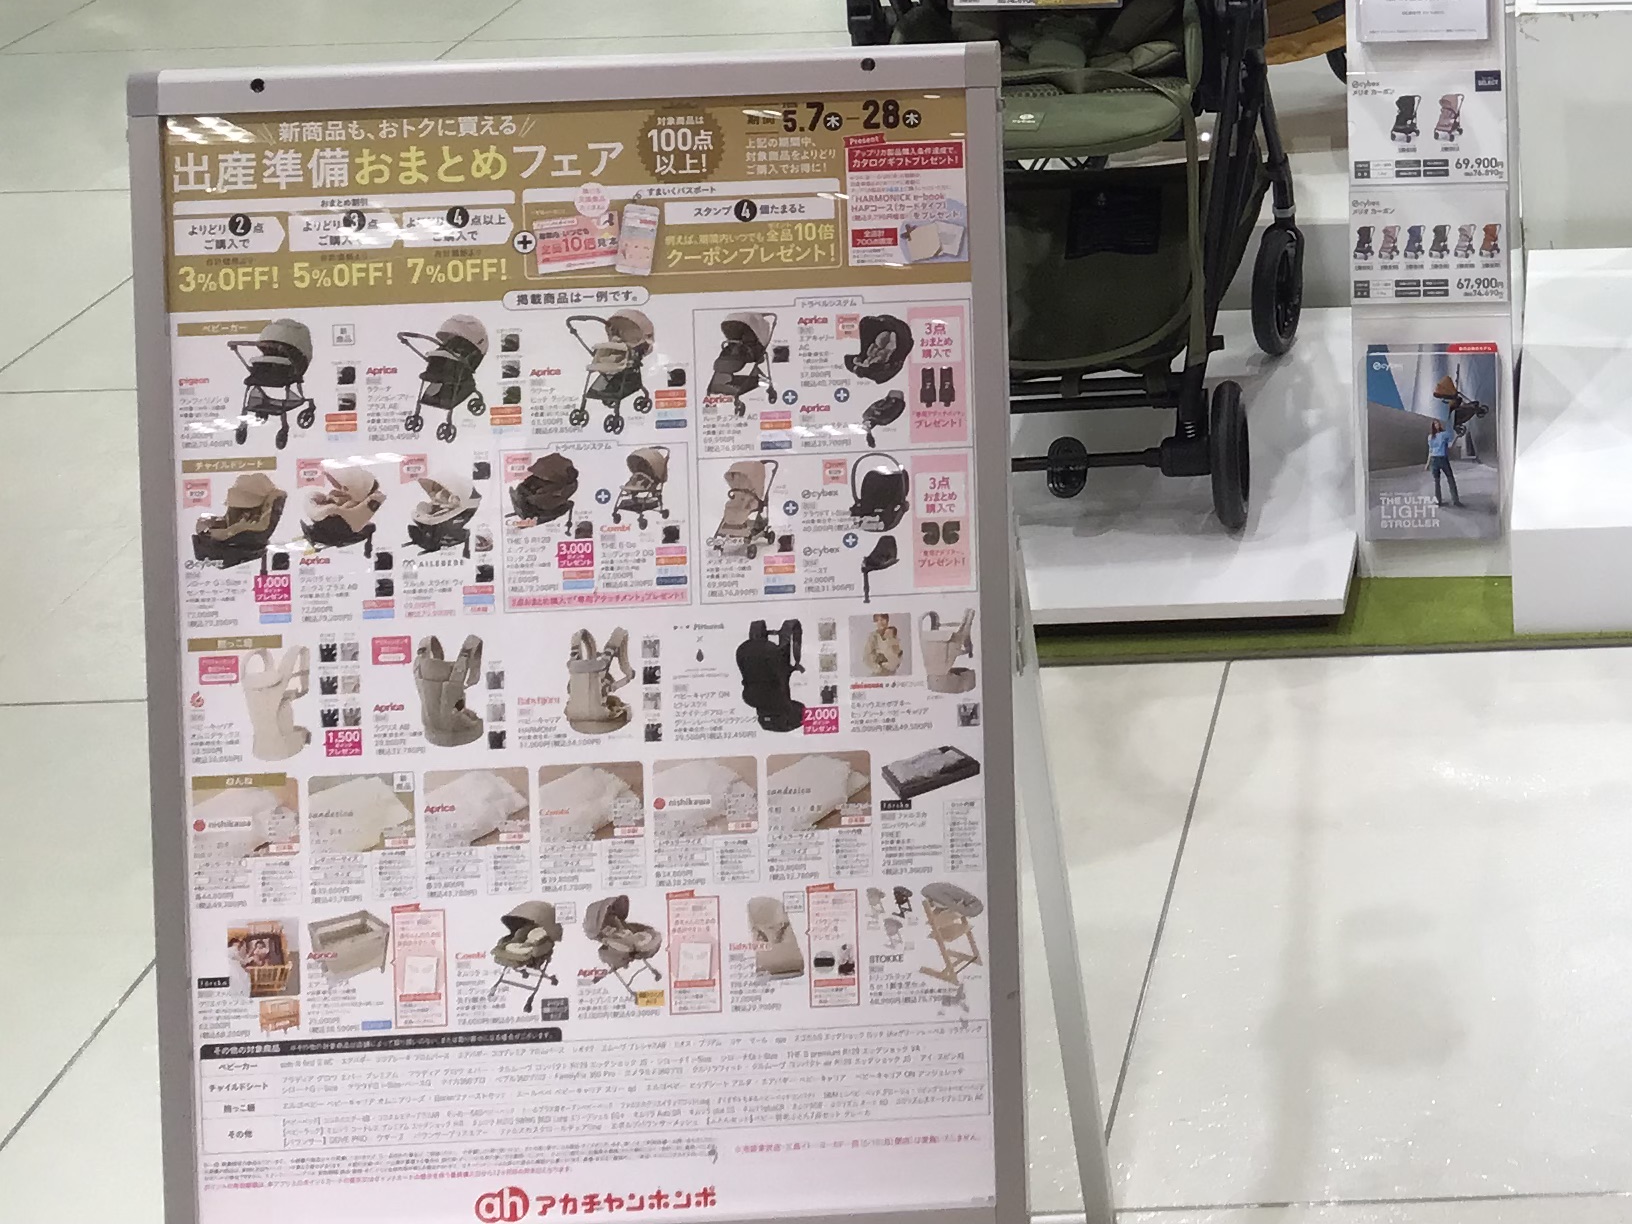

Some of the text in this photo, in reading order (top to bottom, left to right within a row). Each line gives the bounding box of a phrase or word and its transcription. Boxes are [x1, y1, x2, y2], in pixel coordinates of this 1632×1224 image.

[656, 115, 705, 127] 対象商品は
[278, 116, 517, 142] 新商品も、おトクに買える
[646, 126, 714, 154] 100点
[849, 134, 880, 145] Present
[745, 148, 837, 163] 対象商品をよりどり
[173, 141, 625, 194] 出産準備おまとめフェア
[655, 152, 708, 176] 以上!
[646, 185, 717, 197] すまいくパスポート
[203, 237, 251, 251] ご購入で
[666, 243, 837, 269] クーポンプレゼント!
[178, 256, 508, 293] 3%OFF! 5%OFF! 7%OFF!
[515, 288, 639, 306] 掲載商品は一例です。
[799, 297, 858, 309] トラベルシステム
[201, 323, 247, 333] ベビーカー
[924, 322, 946, 336] 3点
[919, 337, 954, 348] おまとめ
[366, 365, 398, 375] Aprica
[530, 367, 561, 377] Aprica
[927, 476, 951, 490] 3点
[1380, 496, 1401, 505] THE
[1380, 505, 1439, 520] LIGHT
[1380, 519, 1440, 529] STROLLER
[558, 542, 593, 555] 3,000
[300, 556, 331, 566] Aprica
[256, 576, 289, 588] 1,000
[373, 703, 405, 713] Aprica
[805, 708, 838, 721] 2,000
[326, 730, 360, 743] 1,500
[218, 1062, 259, 1071] ベビーカー
[208, 1081, 269, 1092] チャイルドシート
[227, 1129, 253, 1139] その他
[535, 1185, 717, 1217] アカチャンホンポ
